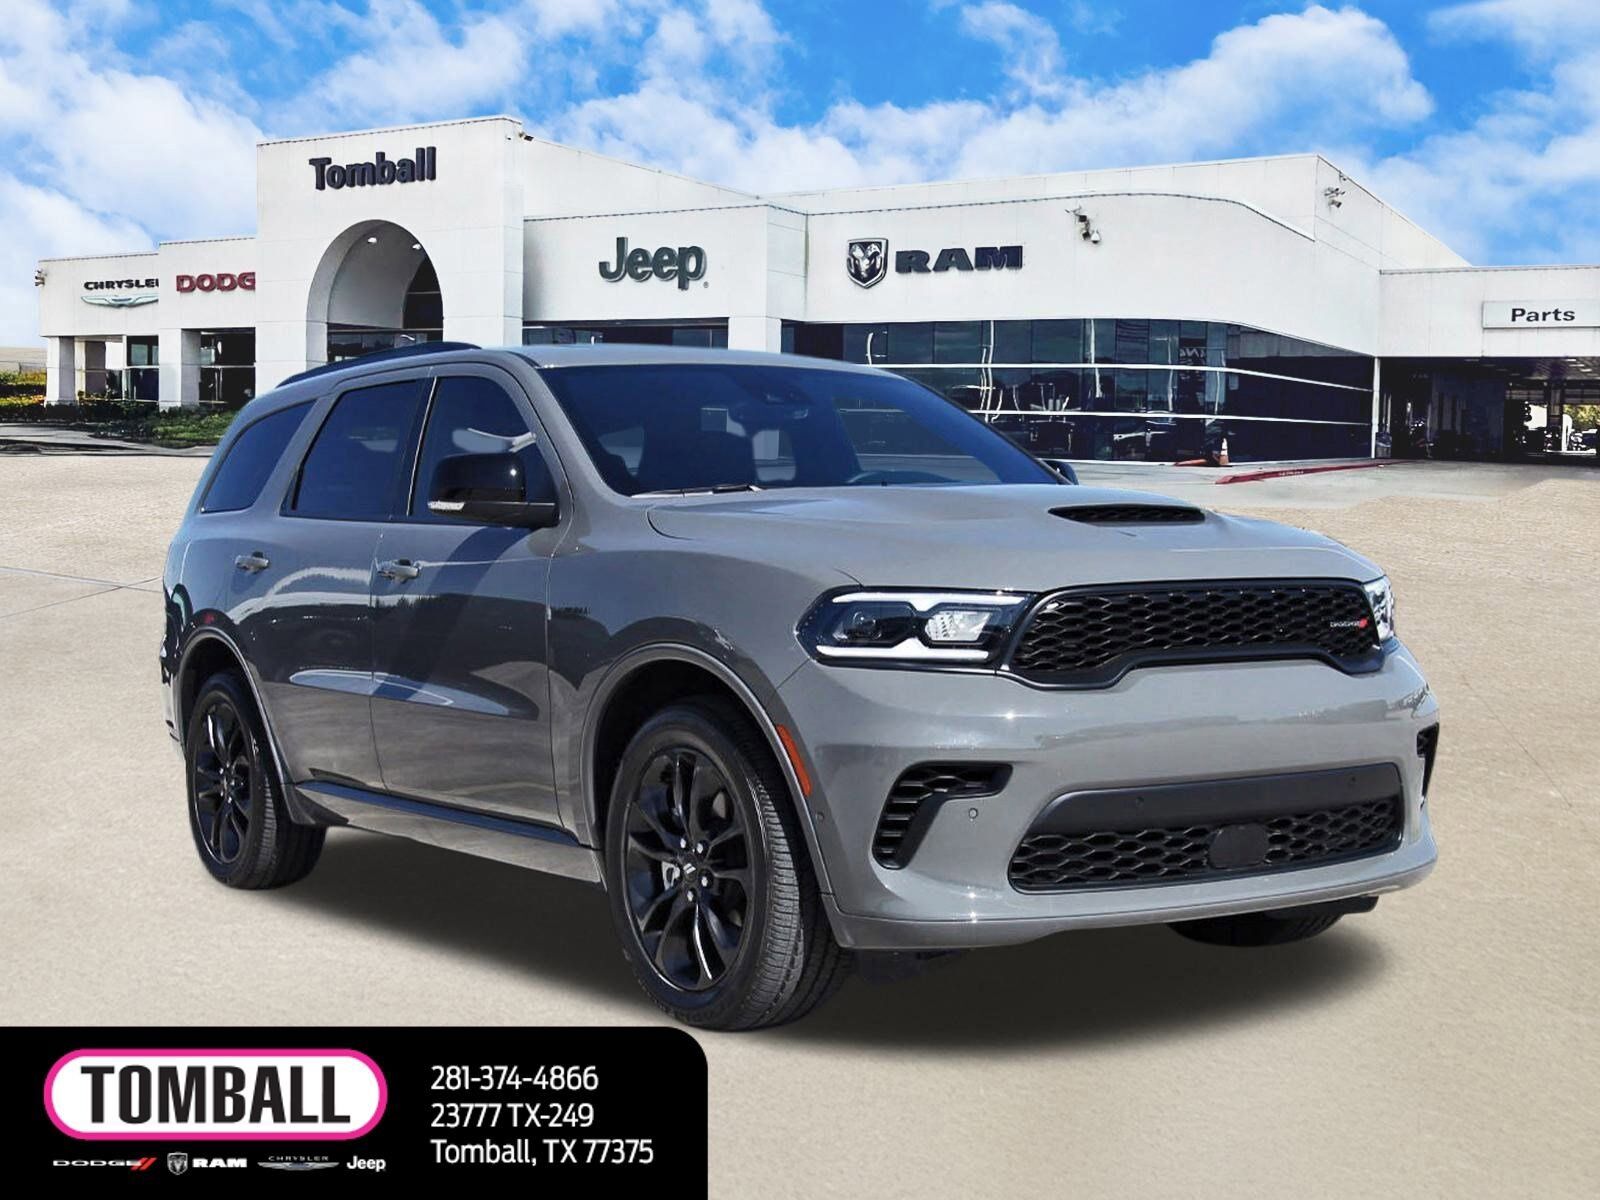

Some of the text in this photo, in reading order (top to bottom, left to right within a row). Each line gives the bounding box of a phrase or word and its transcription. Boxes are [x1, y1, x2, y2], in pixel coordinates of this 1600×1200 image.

[308, 146, 437, 191] Tomball
[599, 237, 707, 291] Jeep
[895, 245, 1023, 274] RAM
[1511, 306, 1576, 323] Parts
